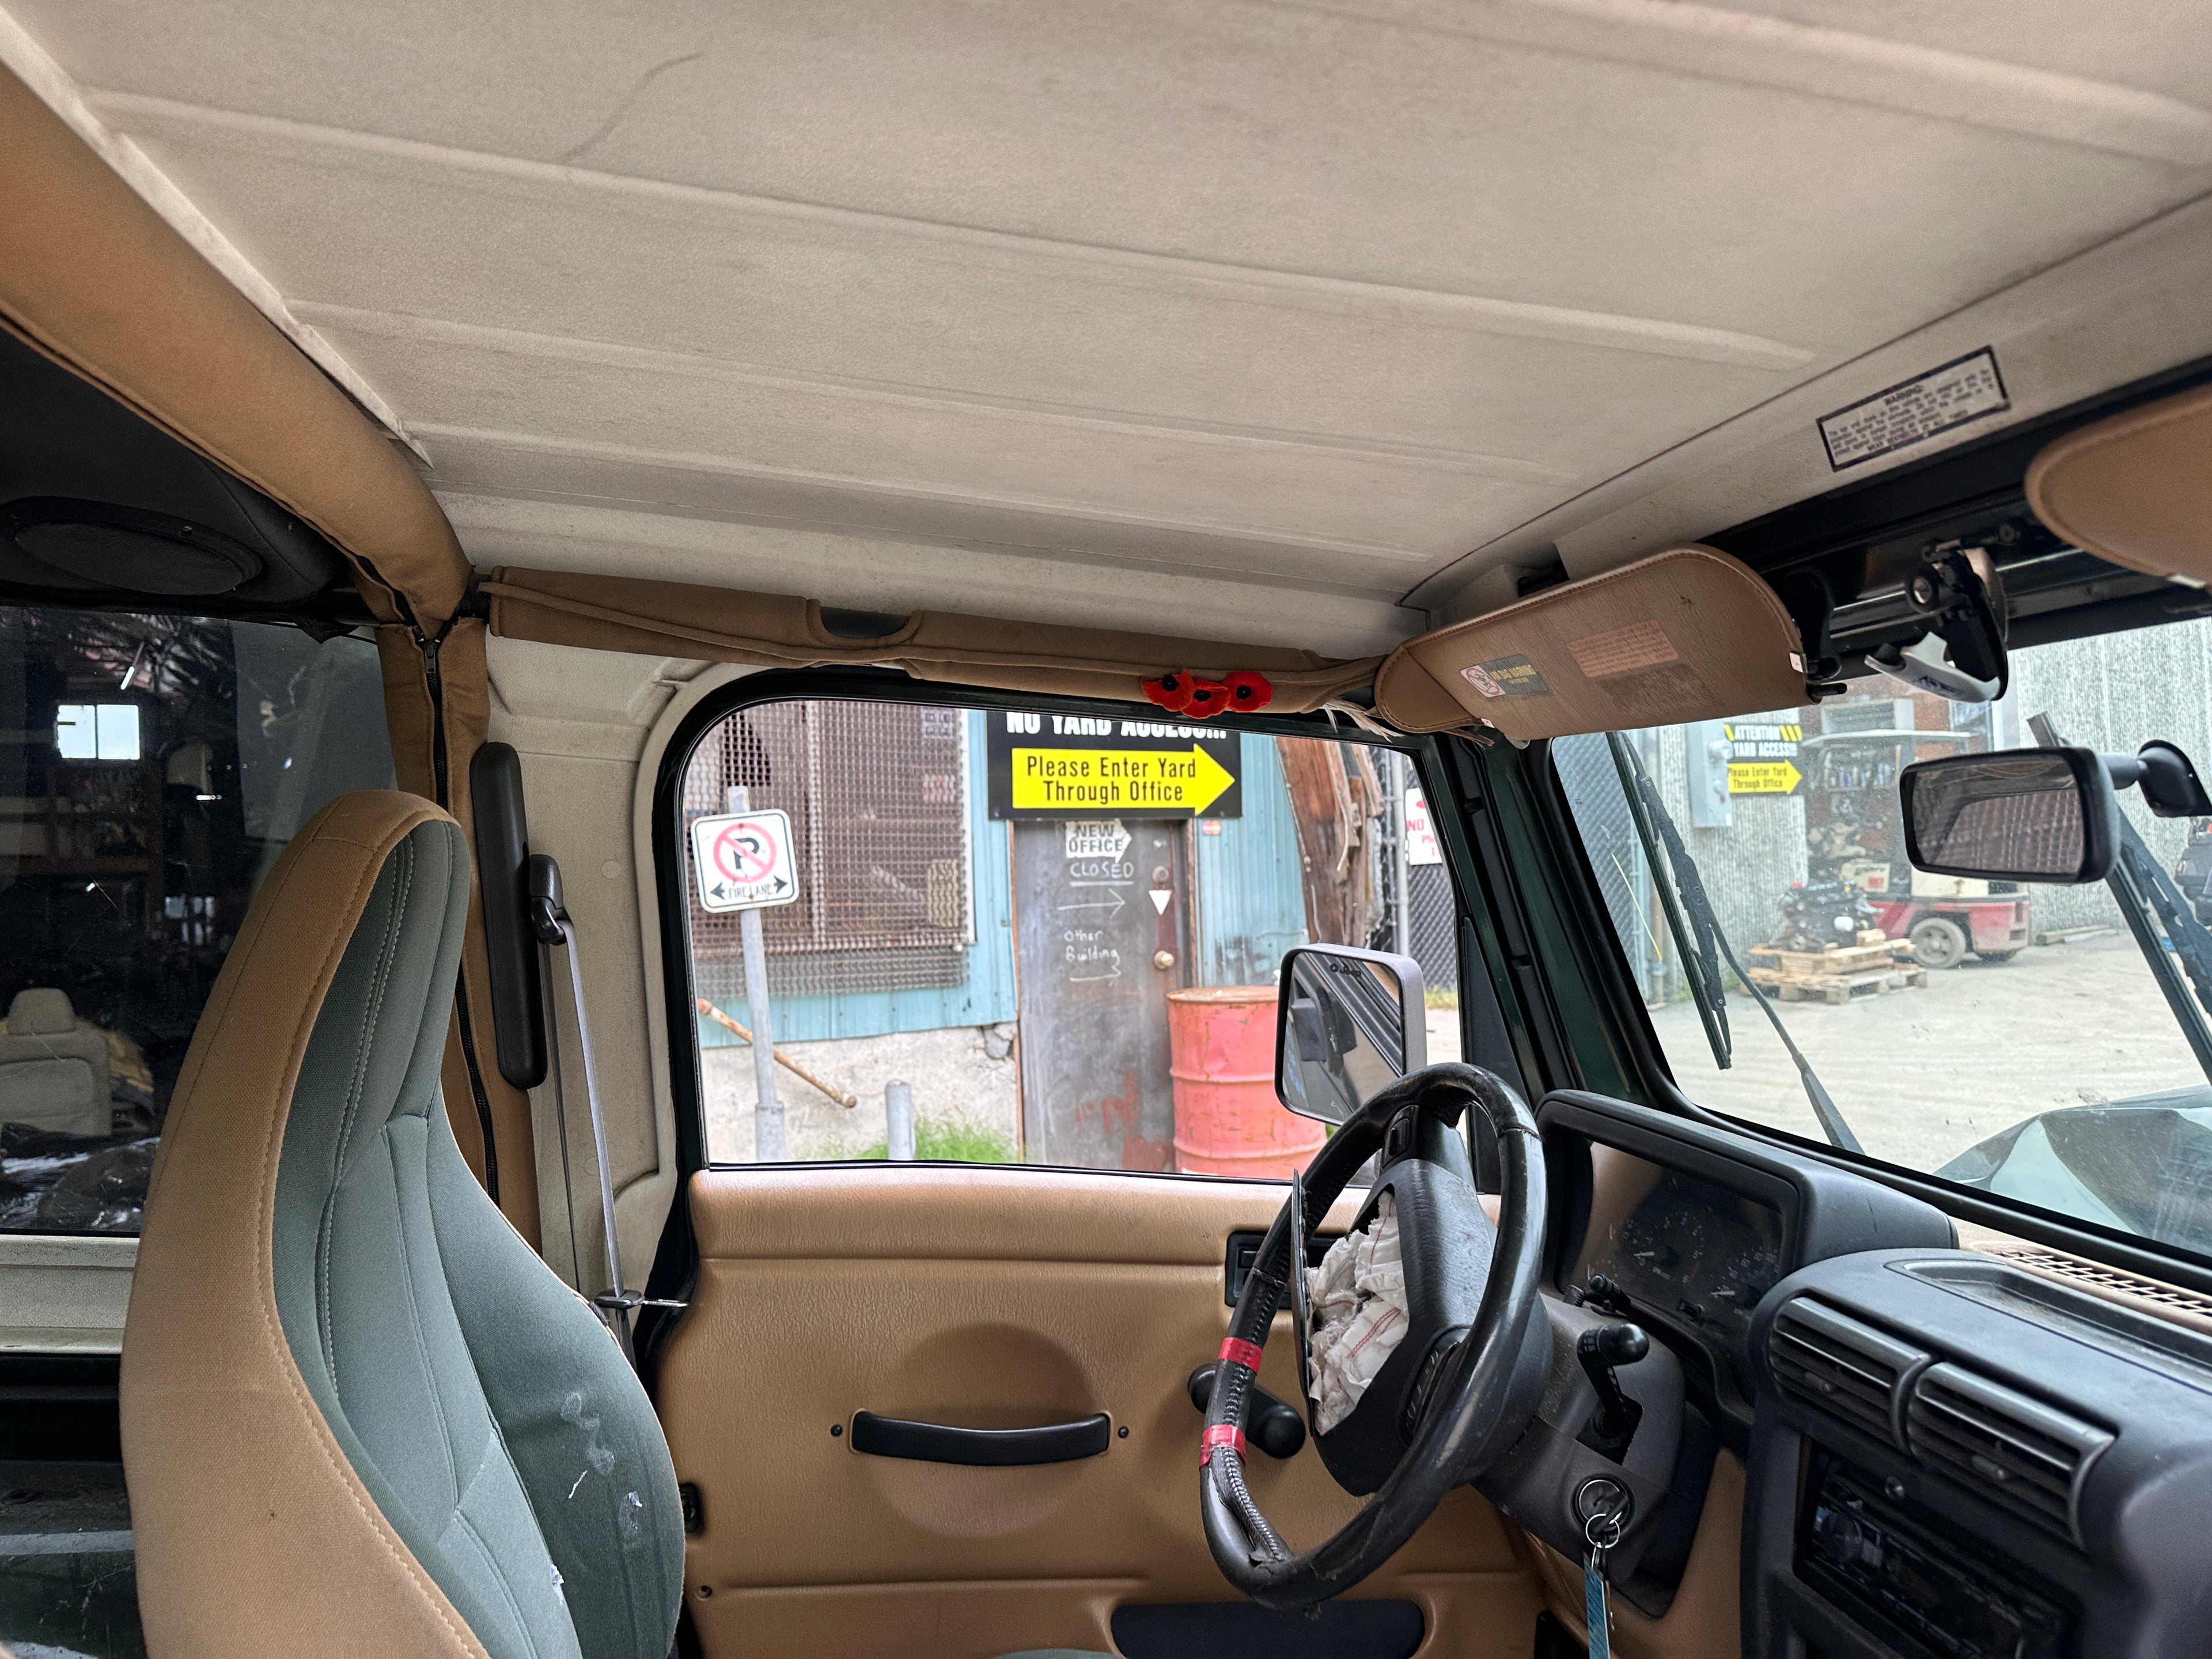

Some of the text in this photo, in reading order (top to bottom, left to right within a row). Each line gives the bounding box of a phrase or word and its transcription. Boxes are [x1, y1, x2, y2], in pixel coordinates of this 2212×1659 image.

[1006, 711, 1041, 734] NO
[1734, 725, 1781, 741] ATTENTION
[1733, 742, 1756, 757] YARD
[1027, 755, 1196, 778] Please Enter Yard
[1043, 780, 1183, 805] Through Office
[1077, 824, 1113, 837] NEW
[1069, 839, 1123, 853] OFFICE
[728, 886, 747, 899] FIRE
